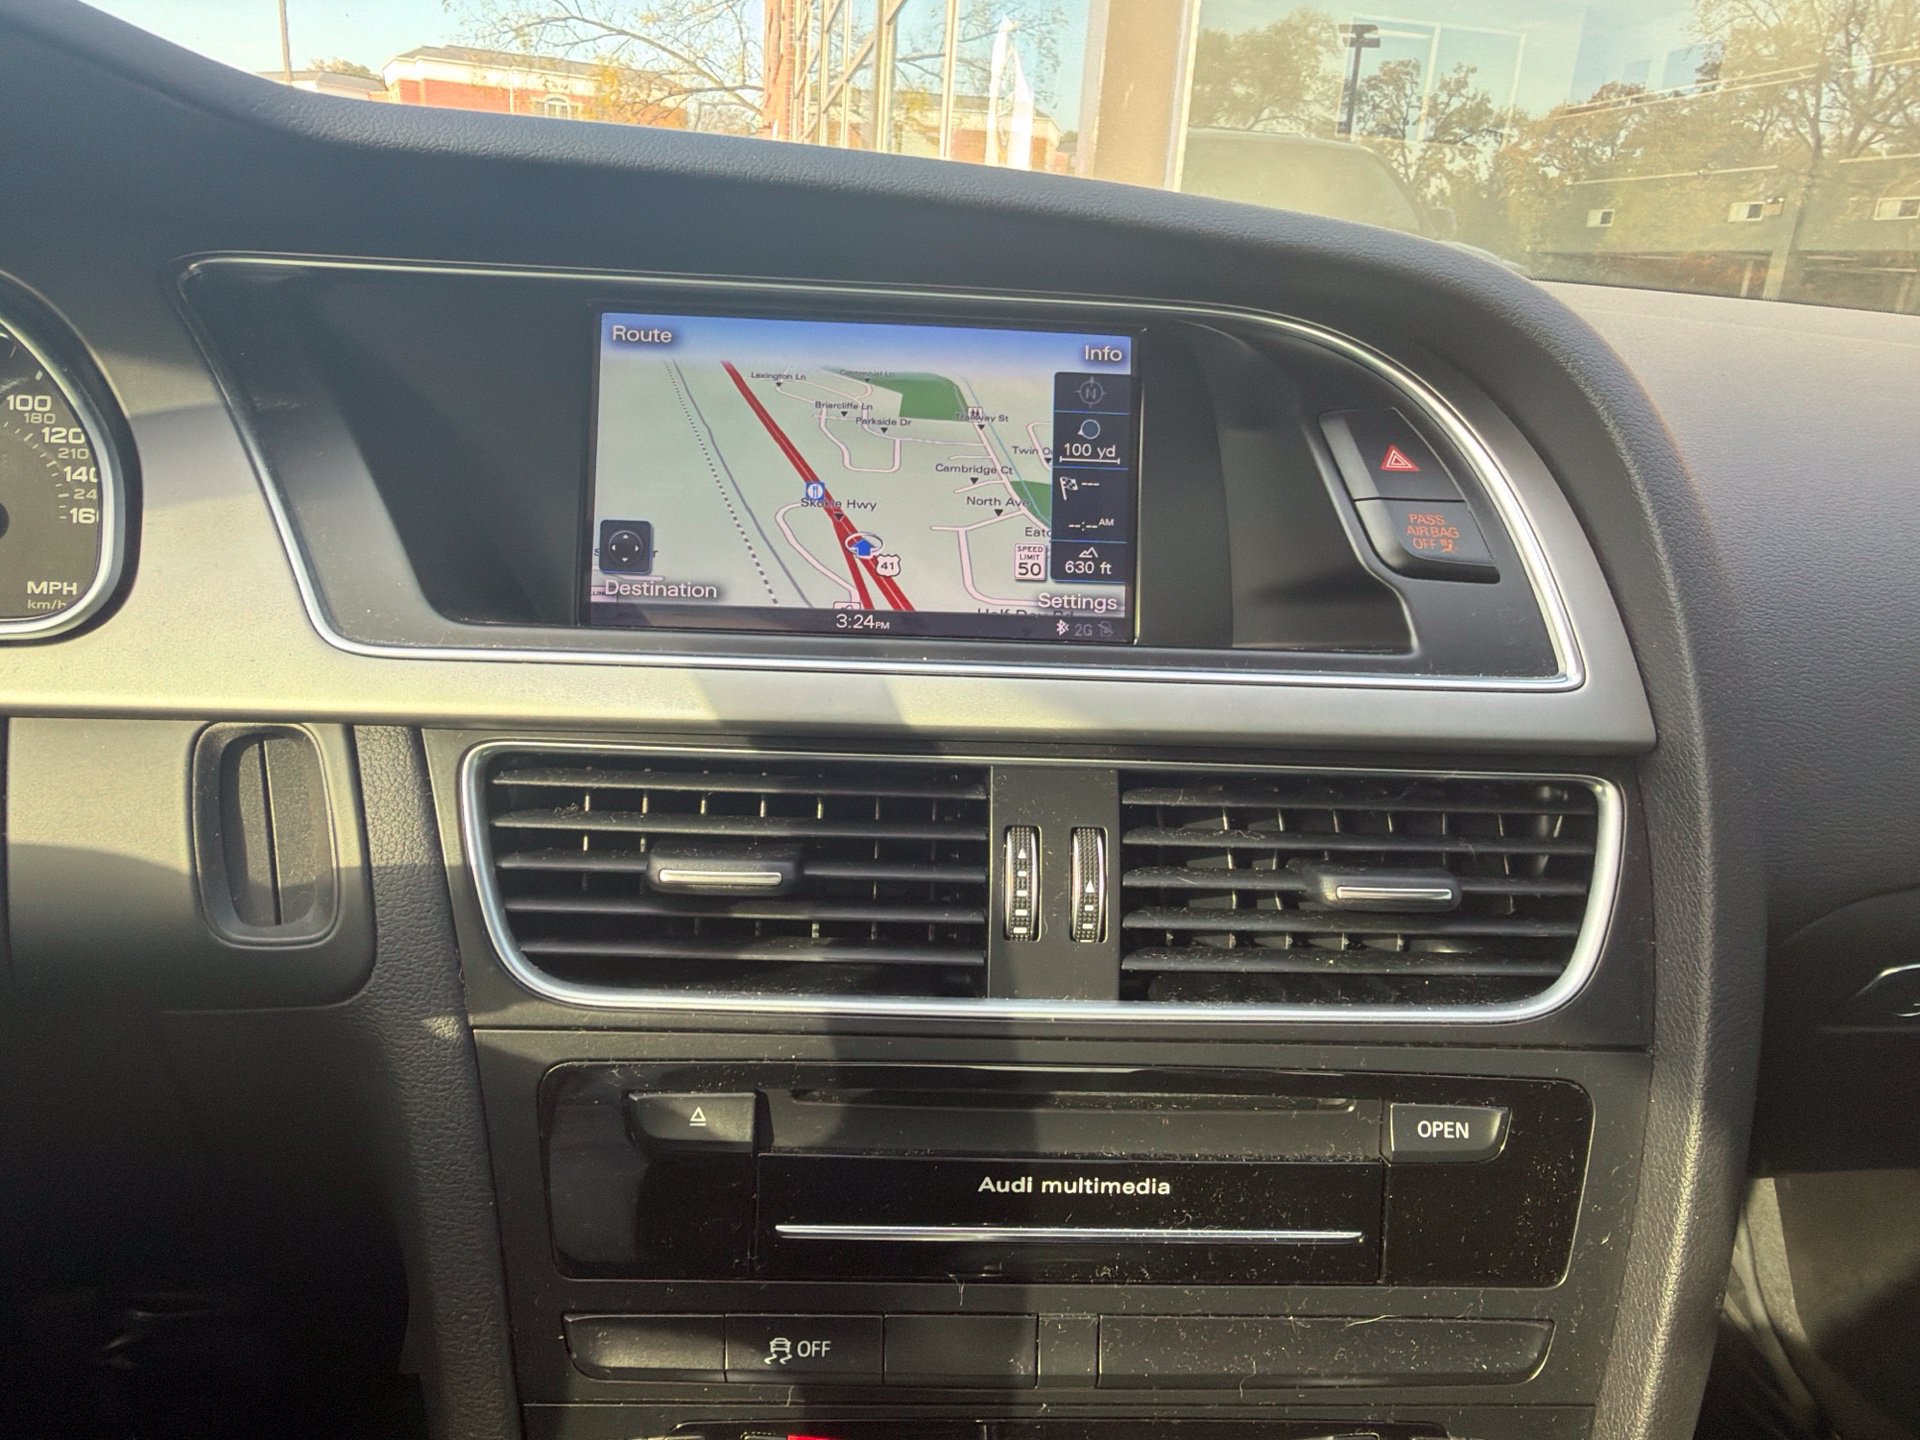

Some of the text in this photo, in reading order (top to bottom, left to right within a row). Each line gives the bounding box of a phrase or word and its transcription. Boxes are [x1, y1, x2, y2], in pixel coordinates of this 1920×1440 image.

[612, 325, 673, 343] Route
[1085, 345, 1123, 361] Info
[751, 371, 806, 382] Lexington Ln
[6, 394, 52, 412] 100
[814, 400, 873, 411] Briarcliffe Ln
[24, 412, 56, 425] 180
[856, 416, 912, 426] Parkside Dr
[998, 414, 1009, 423] St
[41, 427, 86, 445] 120
[57, 447, 90, 460] 210
[1012, 446, 1039, 455] Twin
[1064, 442, 1117, 459] 100 yd
[935, 463, 1013, 475] Cambridge Ct
[801, 497, 877, 512] Skokie Hwy
[967, 496, 1030, 507] North Ave
[1408, 513, 1446, 525] PASS
[1017, 545, 1044, 553] SPEED
[1412, 538, 1437, 550] OFF
[1019, 553, 1041, 561] LIMIT
[880, 561, 896, 571] 41
[1017, 562, 1042, 577] 50
[1065, 561, 1112, 575] 630 ft
[26, 581, 78, 596] MPH
[605, 580, 718, 599] Destination
[27, 599, 67, 611] km/h
[1038, 592, 1118, 614] Settings
[1074, 623, 1094, 637] 2G
[1417, 1120, 1470, 1139] OPEN
[977, 1176, 1171, 1196] Audi multimedia
[796, 1340, 832, 1358] OFF
